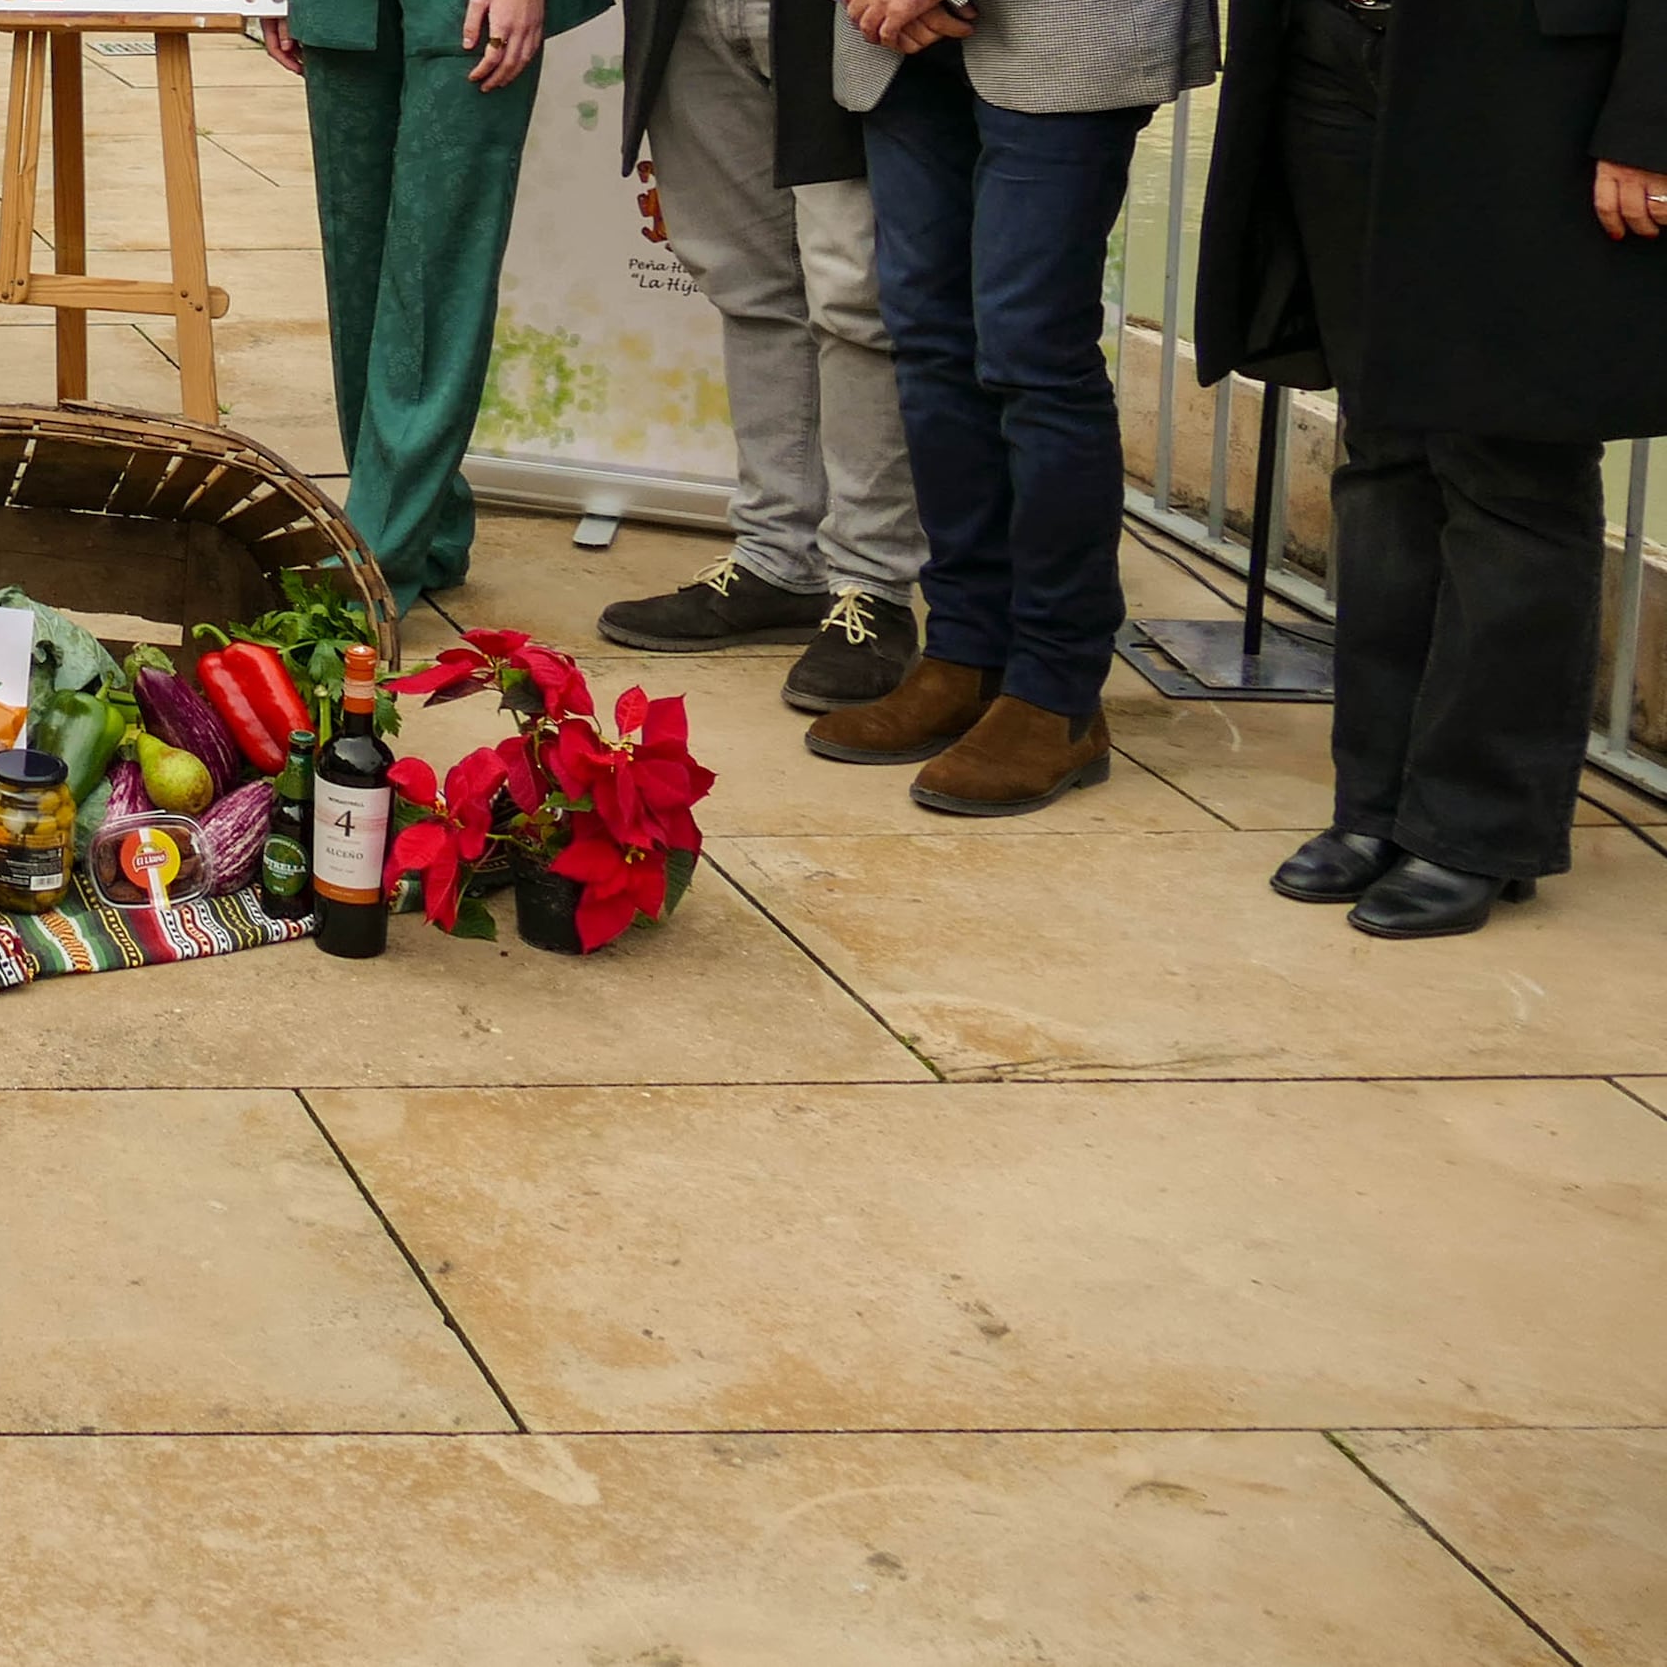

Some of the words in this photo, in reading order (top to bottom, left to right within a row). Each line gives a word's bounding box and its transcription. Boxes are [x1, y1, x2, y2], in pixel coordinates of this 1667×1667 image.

[628, 258, 668, 271] Peña
[334, 810, 355, 837] 4
[326, 846, 364, 860] ALCEÑO
